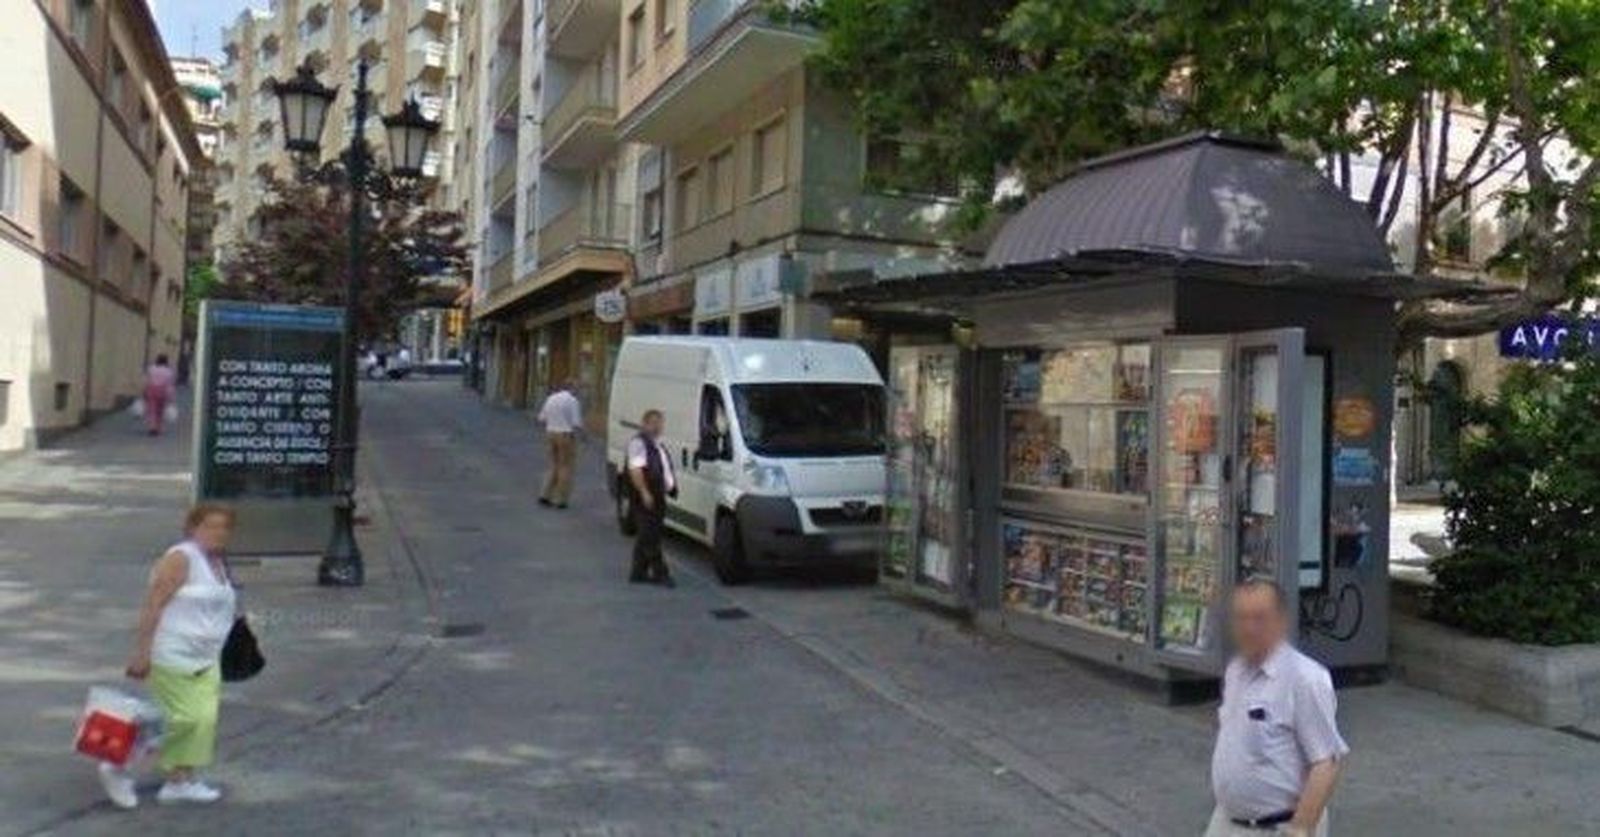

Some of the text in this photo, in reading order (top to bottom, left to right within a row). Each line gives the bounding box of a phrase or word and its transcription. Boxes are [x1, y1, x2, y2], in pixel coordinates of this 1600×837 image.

[219, 360, 246, 372] CON
[249, 361, 287, 373] TANTO
[230, 376, 294, 389] CONCEPTO
[305, 378, 332, 390] CON
[217, 390, 257, 403] TANTO
[301, 408, 331, 420] CON
[216, 421, 257, 433] TANTO
[215, 451, 243, 464] CON
